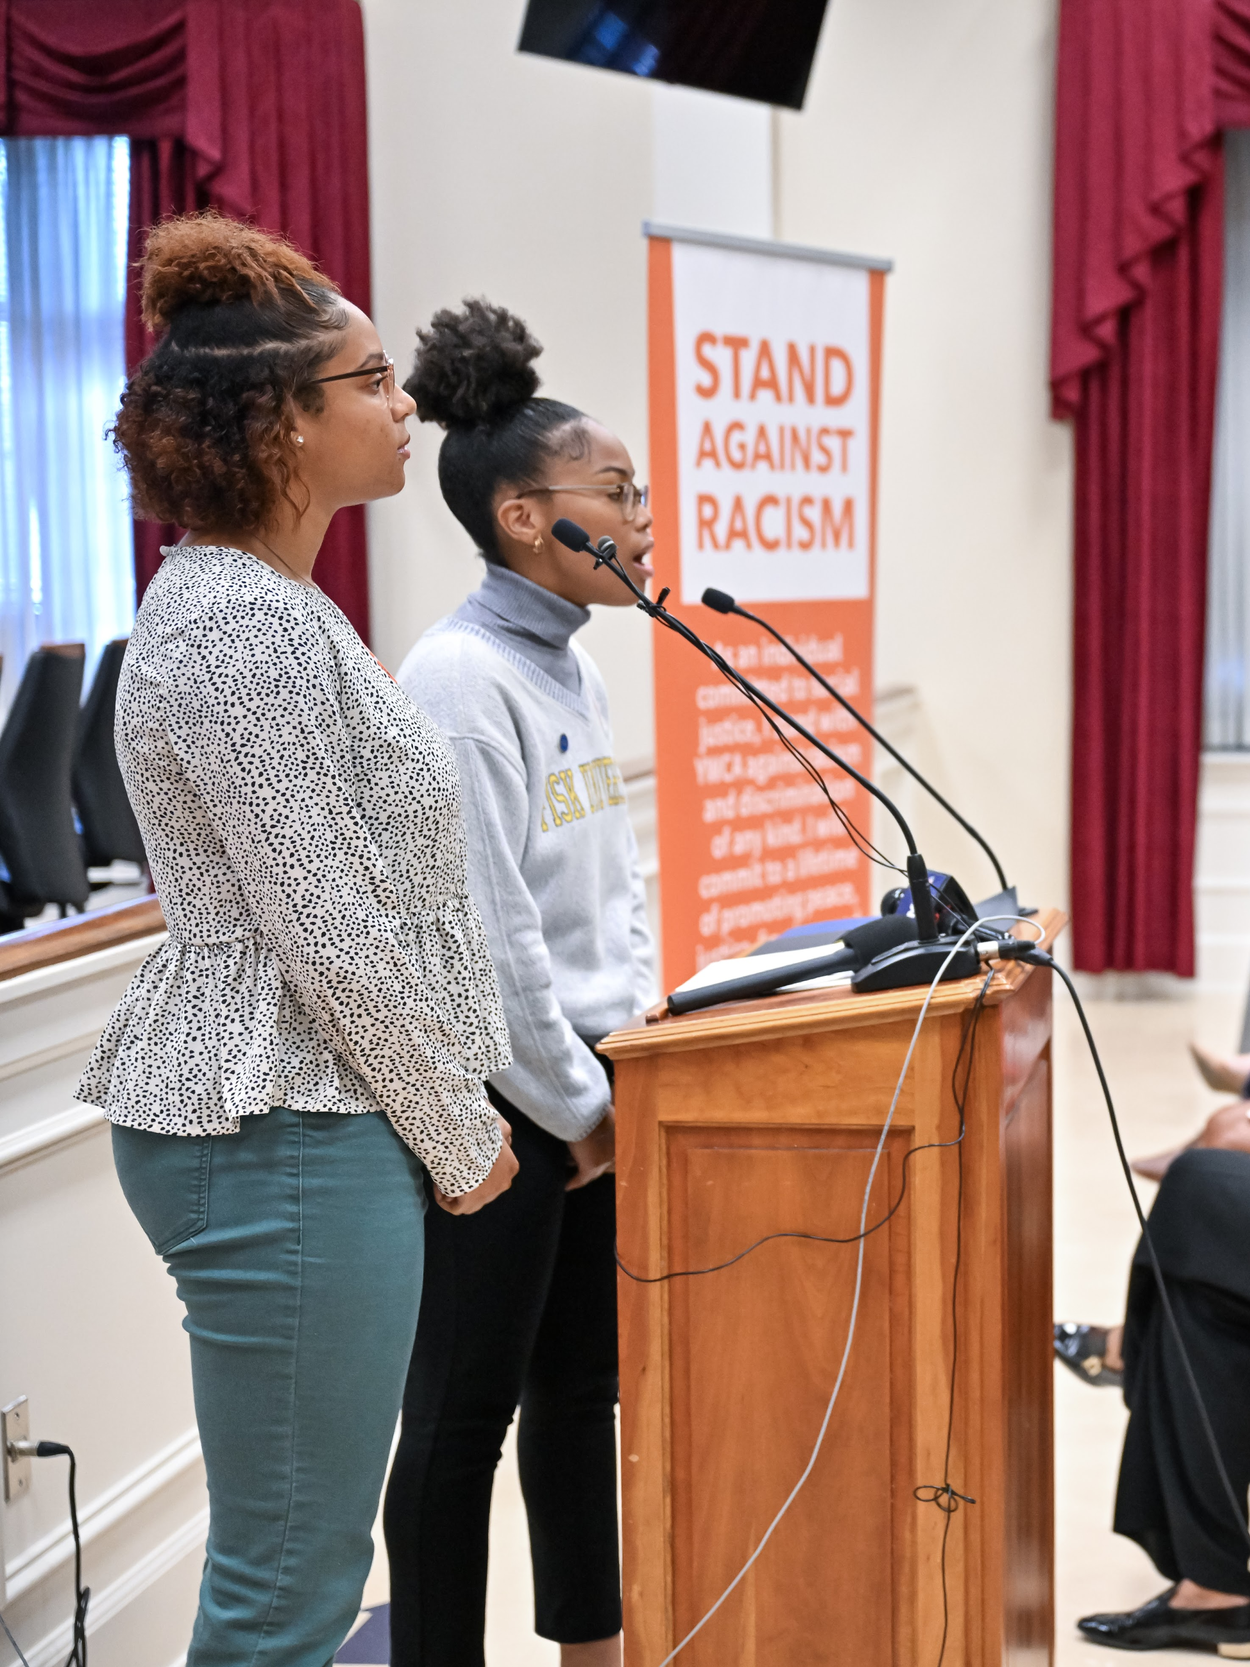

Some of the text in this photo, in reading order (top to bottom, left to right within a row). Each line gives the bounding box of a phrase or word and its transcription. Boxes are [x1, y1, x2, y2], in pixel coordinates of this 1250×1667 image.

[694, 330, 855, 408] STAND
[695, 419, 855, 473] AGAINST
[696, 493, 855, 552] RACISM
[693, 752, 742, 786] YWCA
